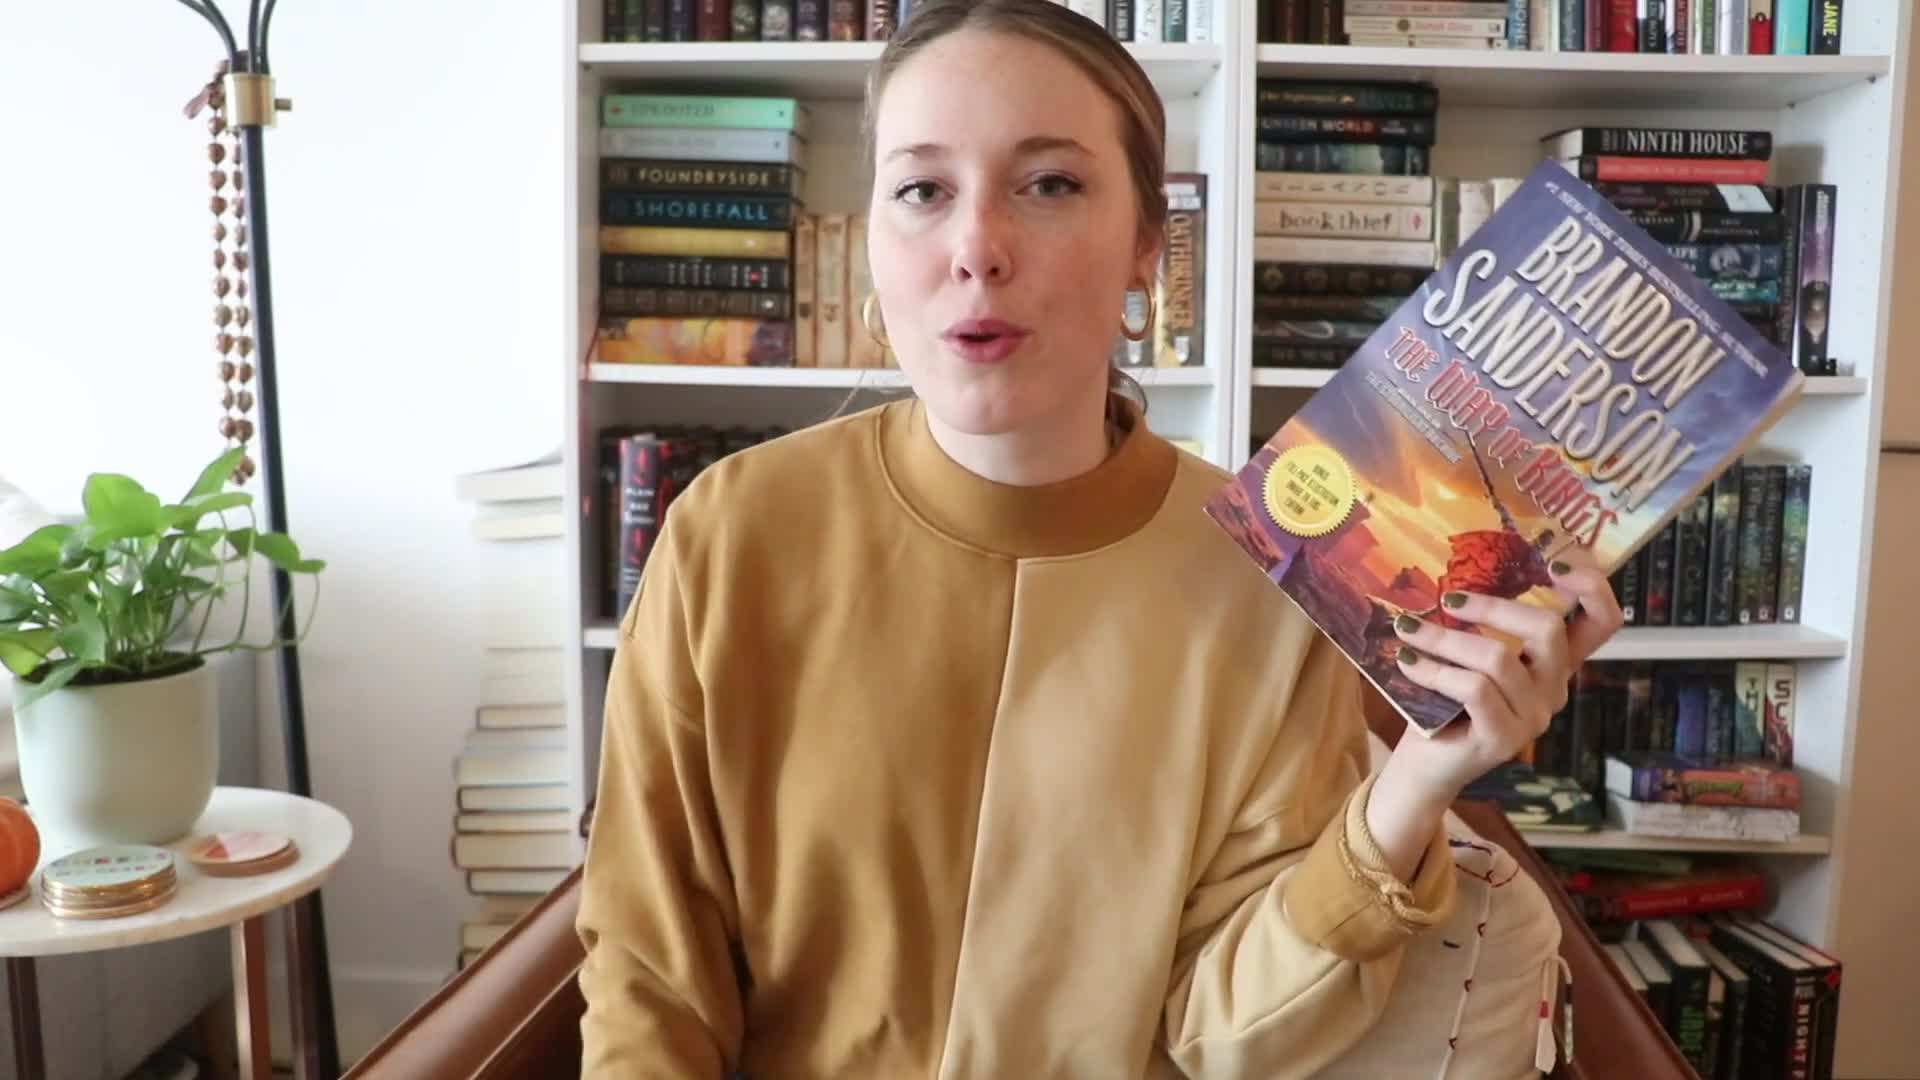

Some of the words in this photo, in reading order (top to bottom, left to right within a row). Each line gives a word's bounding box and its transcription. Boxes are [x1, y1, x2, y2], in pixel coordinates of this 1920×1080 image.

[1822, 1, 1838, 37] JANE
[1322, 119, 1375, 133] WORLD
[1626, 129, 1685, 154] NINTH
[1688, 131, 1749, 155] HOUSE
[638, 167, 770, 187] FOUNDRYSIDE
[634, 200, 769, 221] SHOREFALL
[1279, 208, 1334, 231] book
[1339, 211, 1393, 231] thief
[1517, 215, 1727, 411] BRANDON
[1423, 248, 1697, 512] SANDERSON
[1384, 326, 1440, 383] THE
[1424, 358, 1511, 447] WAY
[1487, 425, 1534, 469] OF
[1514, 446, 1619, 547] KINGS
[1793, 1003, 1811, 1063] NIGHT
